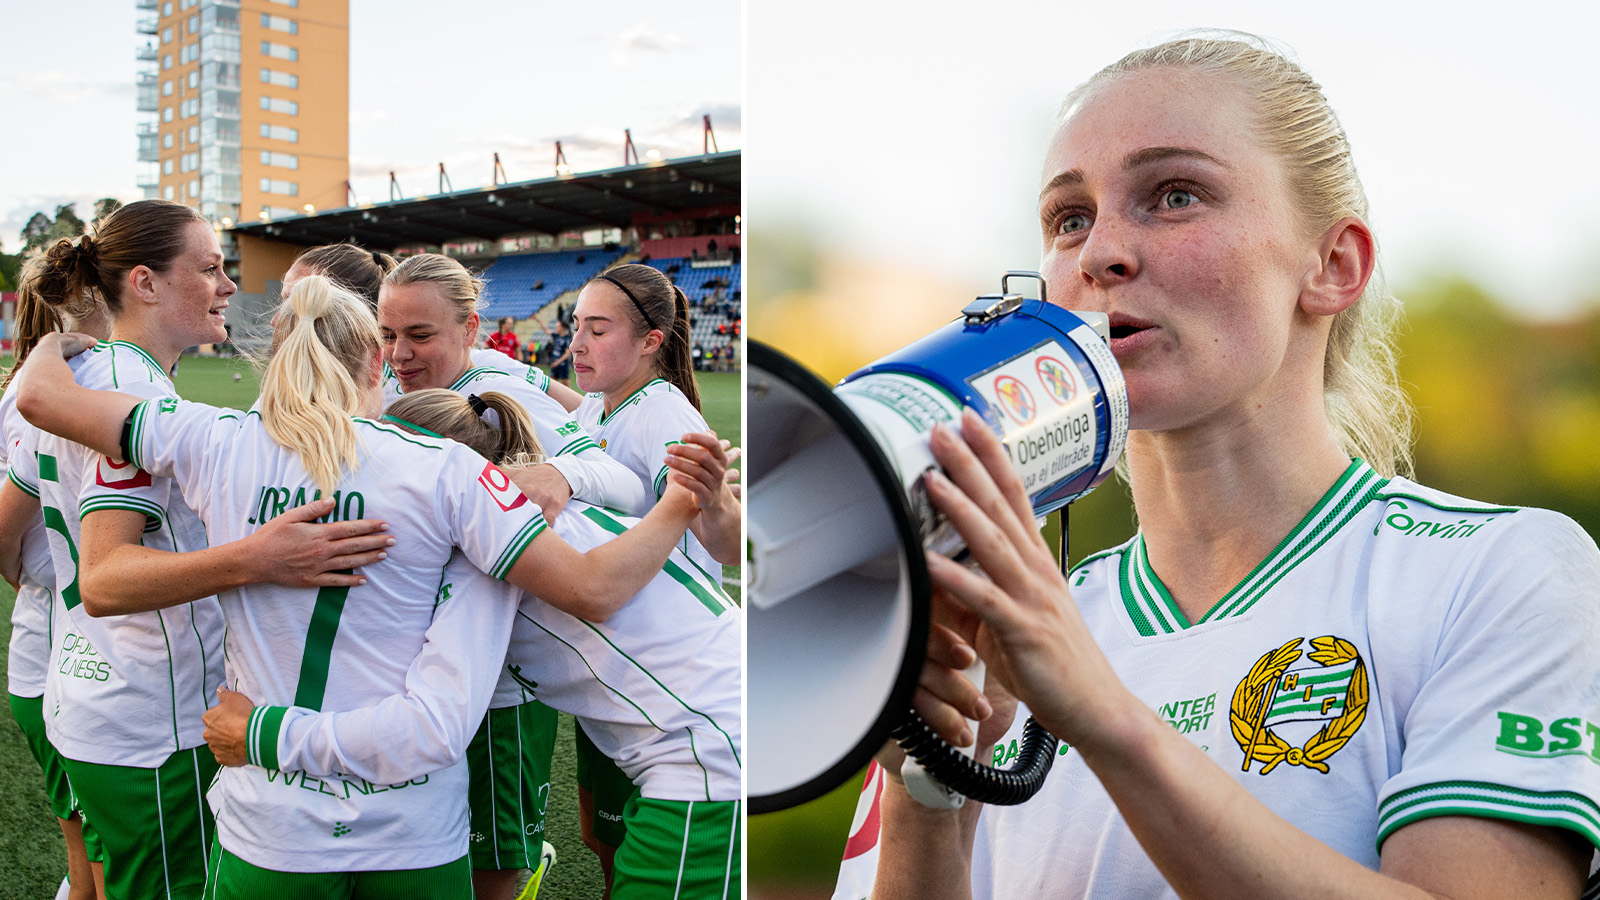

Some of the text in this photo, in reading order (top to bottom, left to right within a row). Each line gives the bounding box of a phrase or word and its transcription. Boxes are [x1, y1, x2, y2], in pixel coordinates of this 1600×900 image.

[1018, 413, 1089, 465] Obehöriga
[1051, 442, 1090, 475] tillträde
[1373, 500, 1496, 539] Convini
[598, 809, 623, 823] CRAF
